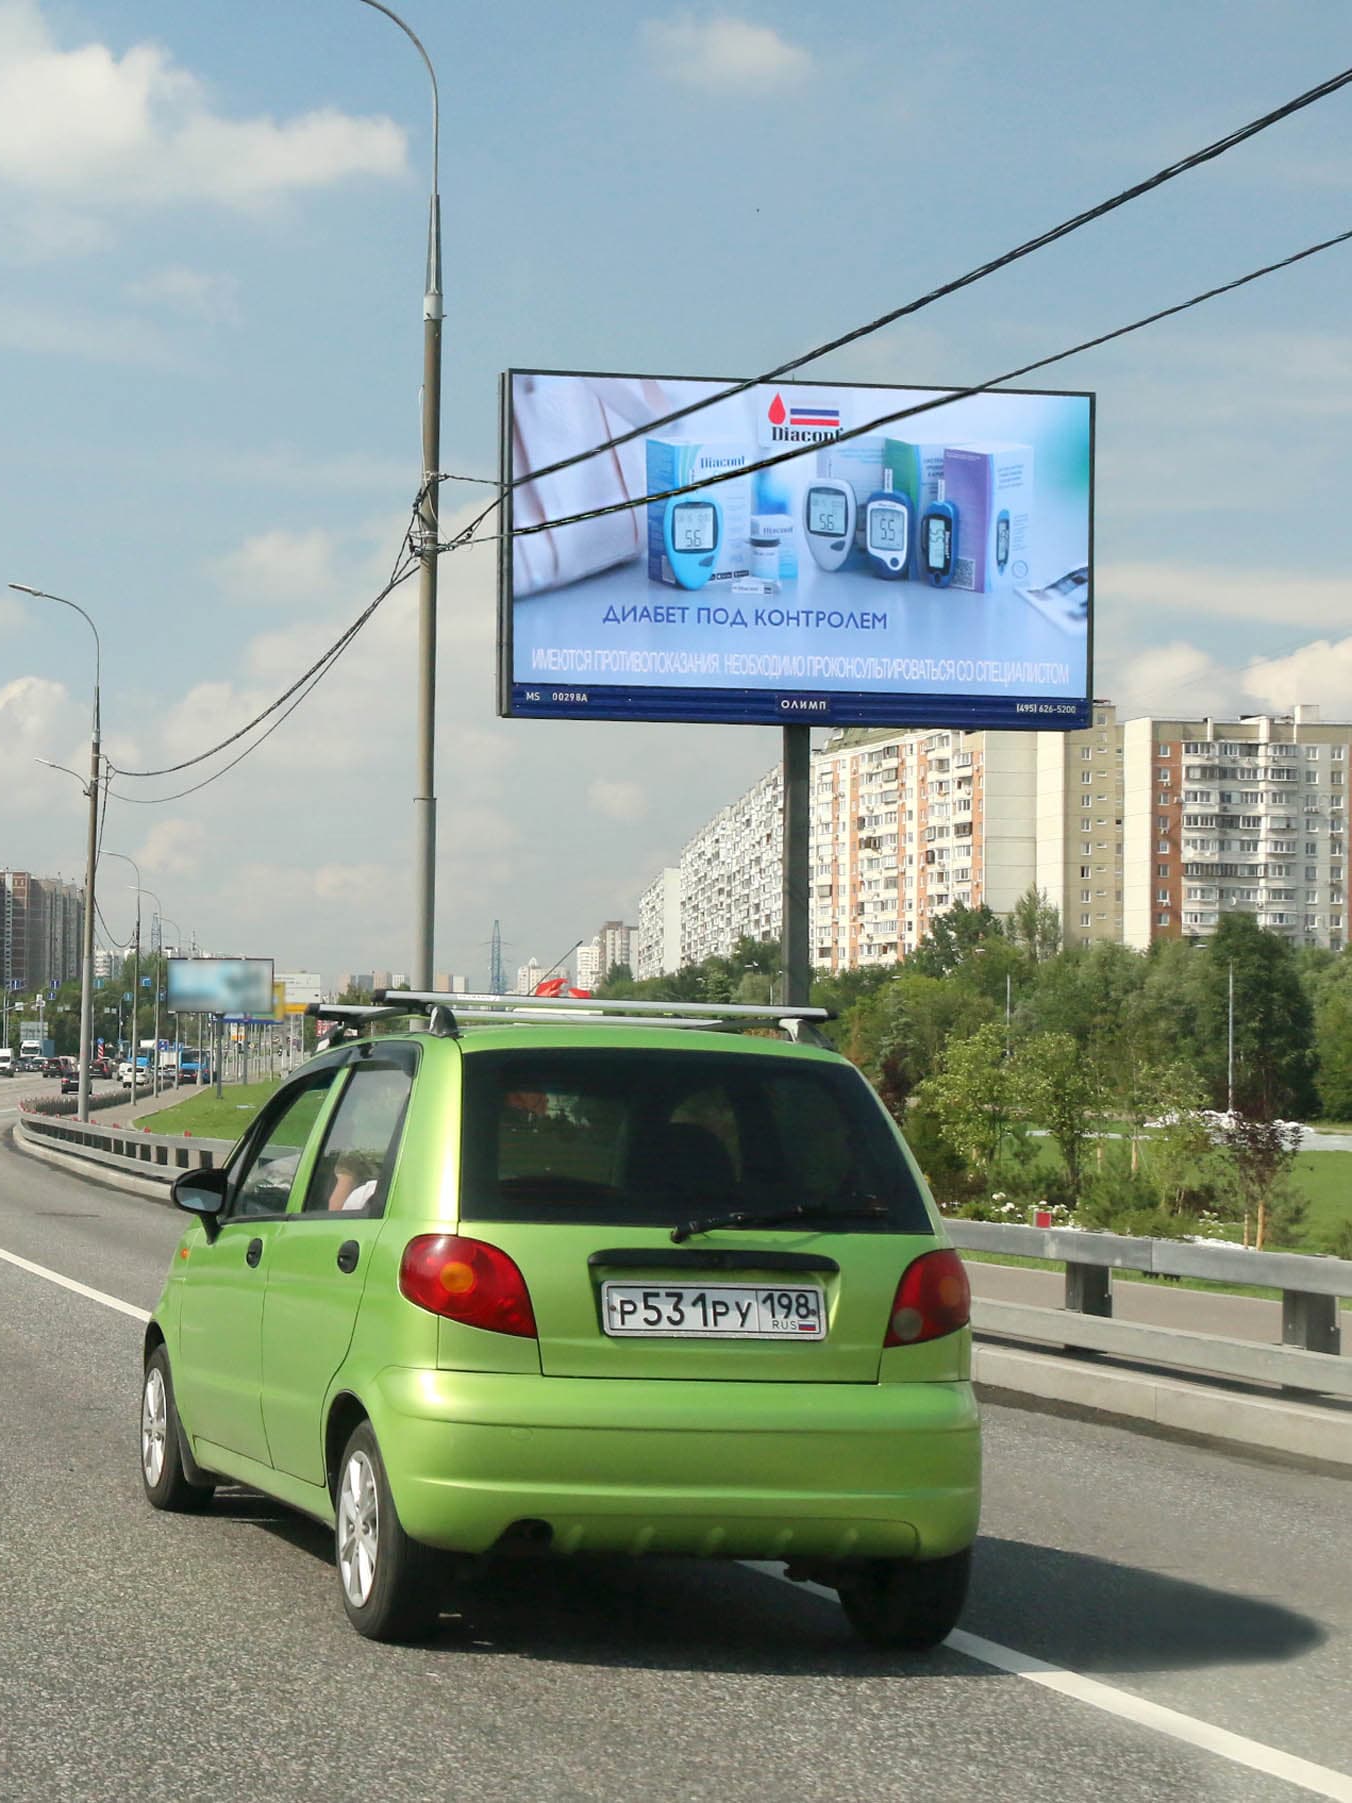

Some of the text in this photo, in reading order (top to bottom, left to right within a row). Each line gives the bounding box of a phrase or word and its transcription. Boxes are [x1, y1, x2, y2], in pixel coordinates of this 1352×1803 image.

[602, 604, 888, 630] ДИАБЕТ ПОД КОНТРОЛЕМ
[531, 647, 593, 672] ИМЕЮТСЯ
[724, 653, 806, 680] НЕОБХОДИМО
[807, 655, 956, 682] ПРОКОНСУЛЬТИРОВАТЬСЯ
[956, 659, 974, 682] СО
[976, 660, 1070, 687] СПЕЦИАЛИСТОМ
[525, 691, 541, 702] MS
[780, 700, 827, 711] ОЛИМП
[1016, 703, 1077, 715] (495) 626-5200
[761, 1291, 811, 1319] 198
[772, 1320, 797, 1331] RUS
